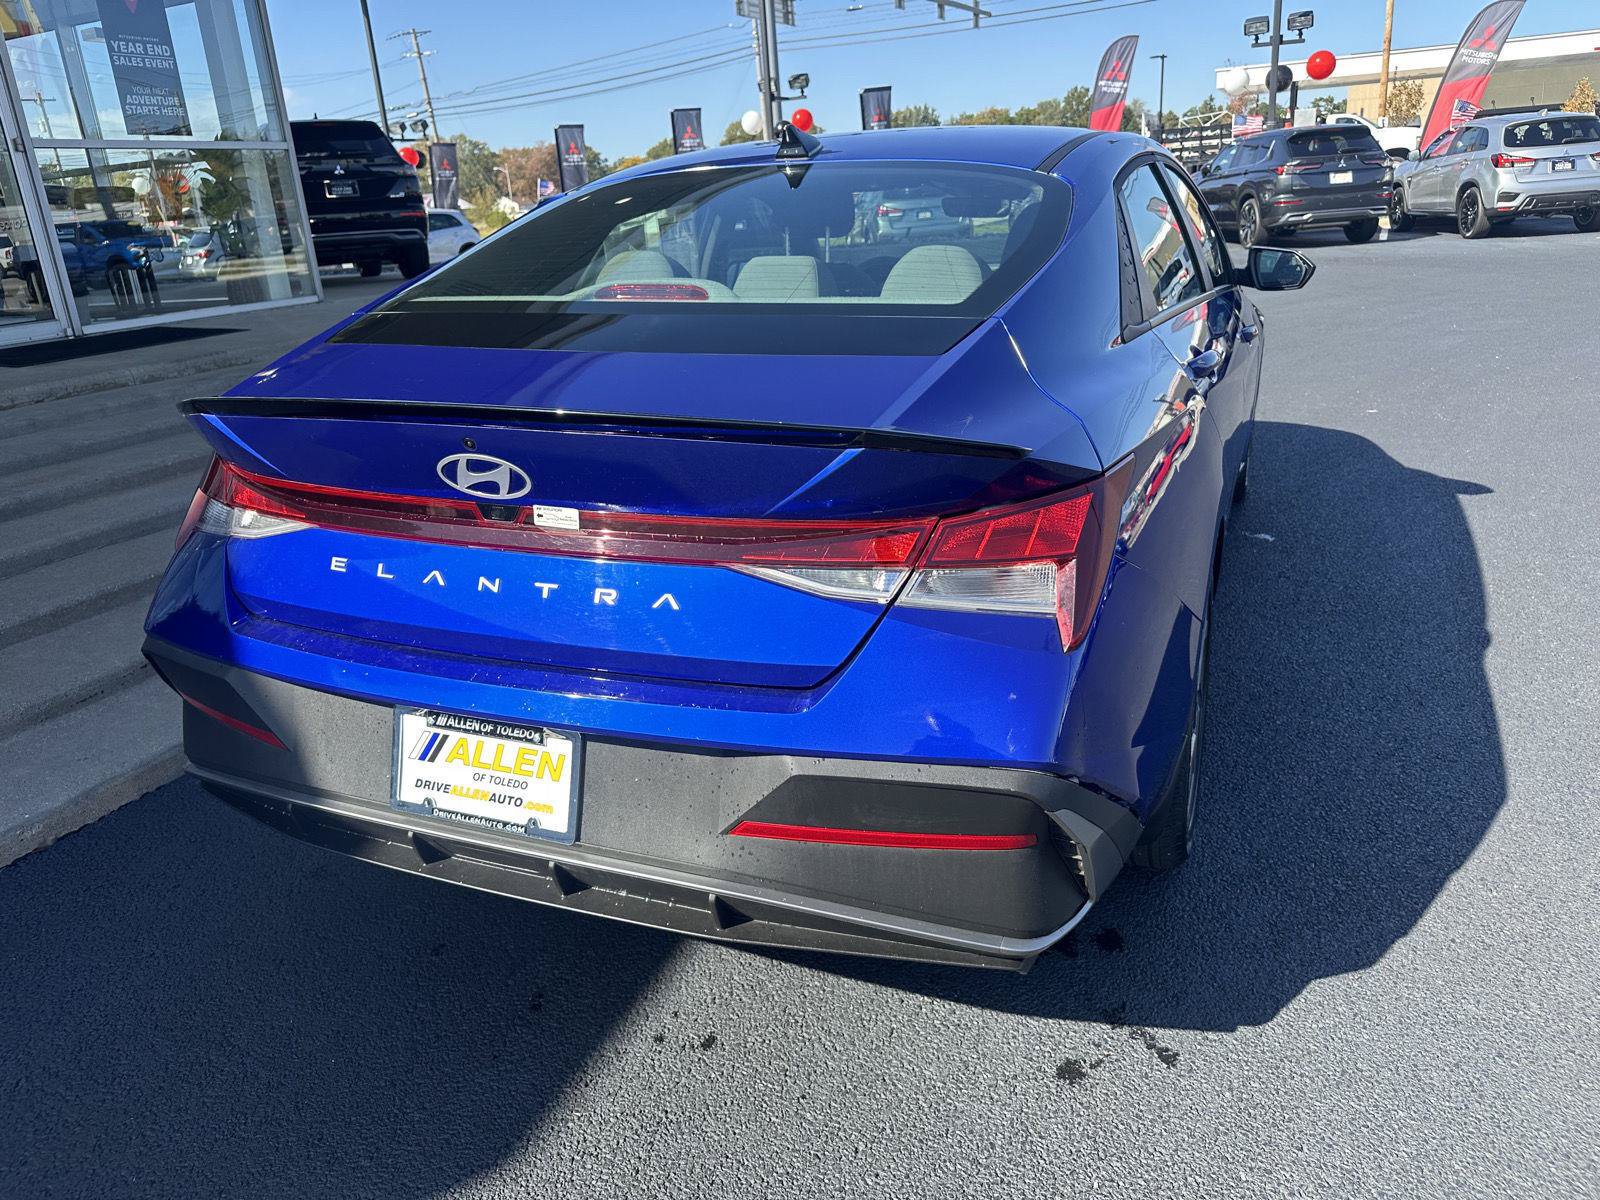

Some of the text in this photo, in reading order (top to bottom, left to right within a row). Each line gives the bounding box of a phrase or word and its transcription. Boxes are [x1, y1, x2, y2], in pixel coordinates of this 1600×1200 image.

[110, 40, 170, 56] YEAR END
[113, 56, 174, 69] SALES EVENT
[1461, 55, 1490, 66] MOTORS
[132, 86, 168, 96] YOUR NEXT
[126, 95, 180, 106] ADVENTURE
[125, 105, 185, 116] STARTS HERE
[330, 556, 680, 611] ELANTRA
[446, 717, 535, 739] ALLEN OF TOLEDO
[445, 737, 566, 782] ALLEN
[472, 772, 529, 790] OF TOLEDO
